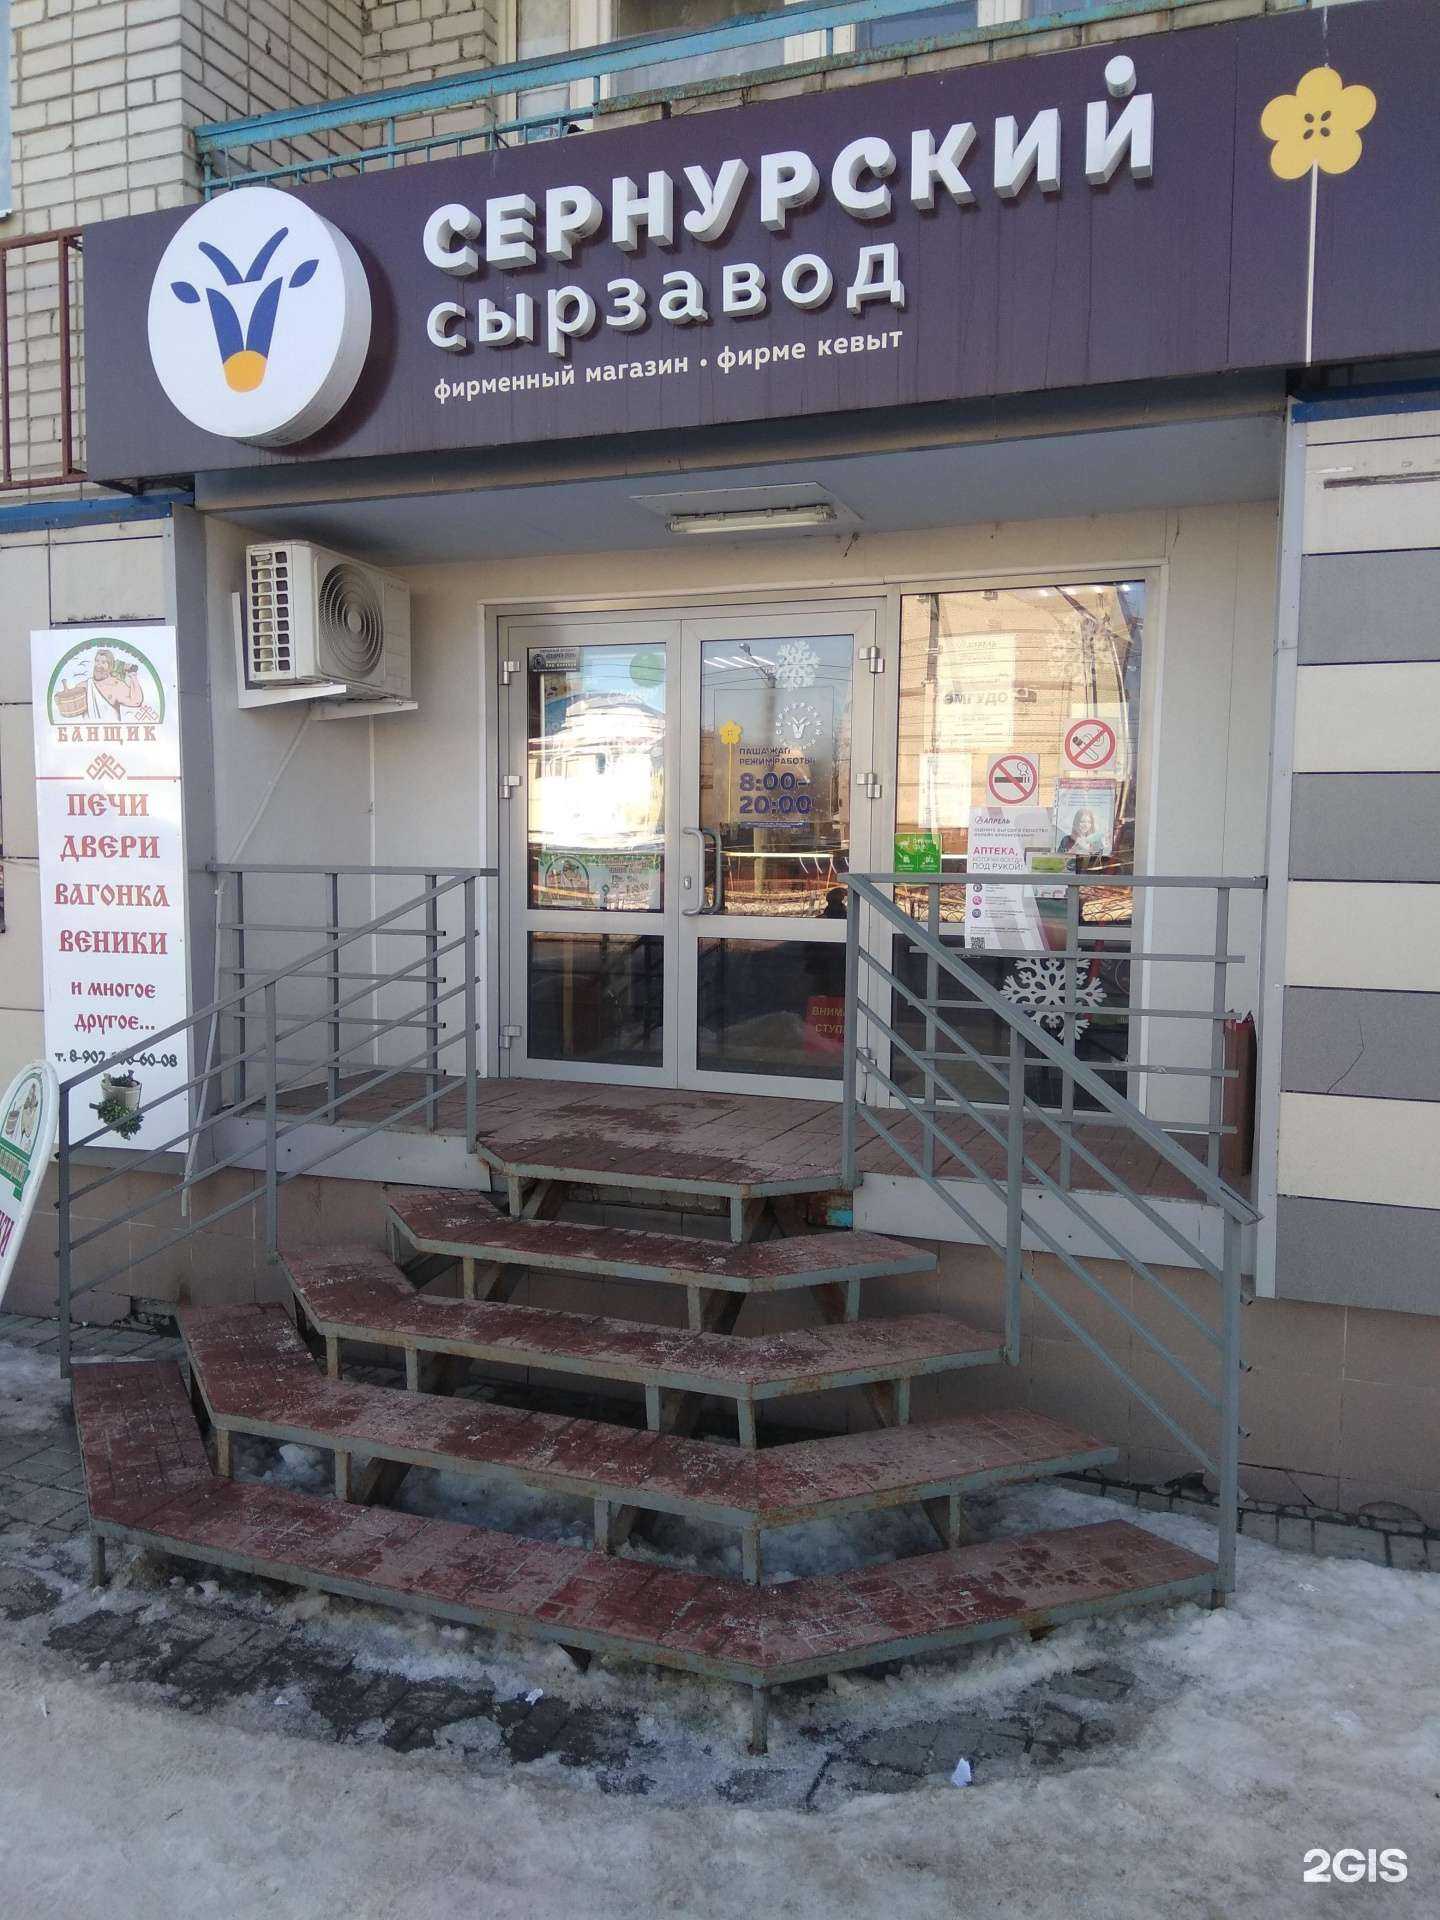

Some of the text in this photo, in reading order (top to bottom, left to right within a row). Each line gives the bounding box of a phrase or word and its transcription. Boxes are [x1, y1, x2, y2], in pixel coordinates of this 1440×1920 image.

[423, 55, 1155, 277] СЕРНУРСКИЙ
[426, 243, 905, 358] сырзавод
[434, 330, 903, 404] фирменный магазин фирме кевыт
[57, 725, 157, 745] БАНЩИК
[66, 793, 150, 817] ПЕЧИ
[739, 795, 811, 814] 20:00
[60, 835, 160, 862] ДВЕРИ
[973, 847, 1018, 856] АПТЕКА,
[972, 862, 990, 871] ПОД
[54, 883, 170, 907] ВАГОНКА
[58, 930, 169, 955] ВЕНИКИ
[87, 982, 156, 999] многое
[812, 1007, 846, 1016] ВНИМ
[55, 1052, 67, 1062] т.
